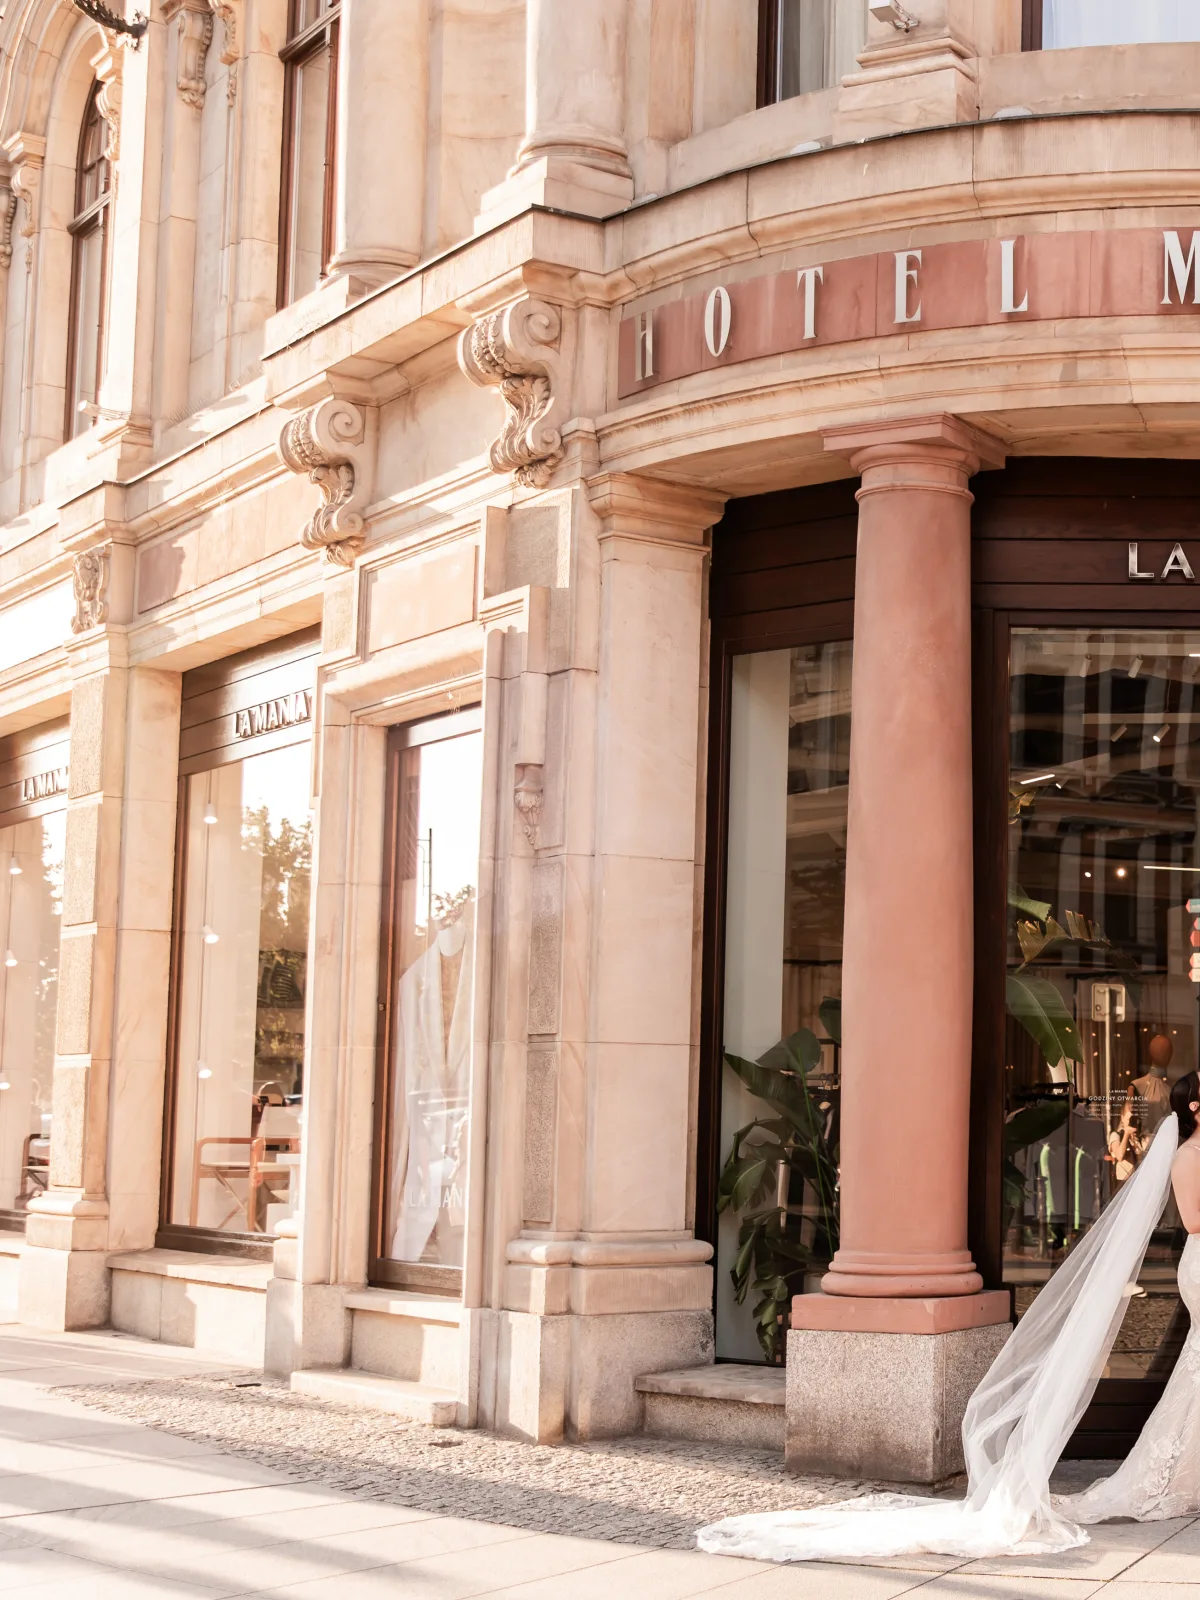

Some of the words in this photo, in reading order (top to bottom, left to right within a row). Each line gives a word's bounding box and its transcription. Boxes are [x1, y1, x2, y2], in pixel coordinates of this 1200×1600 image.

[634, 240, 1028, 381] HOTEL
[1127, 542, 1196, 581] LA
[232, 709, 253, 738] LA
[254, 690, 310, 732] MANIA
[21, 778, 36, 801] LA
[37, 768, 69, 798] MANI
